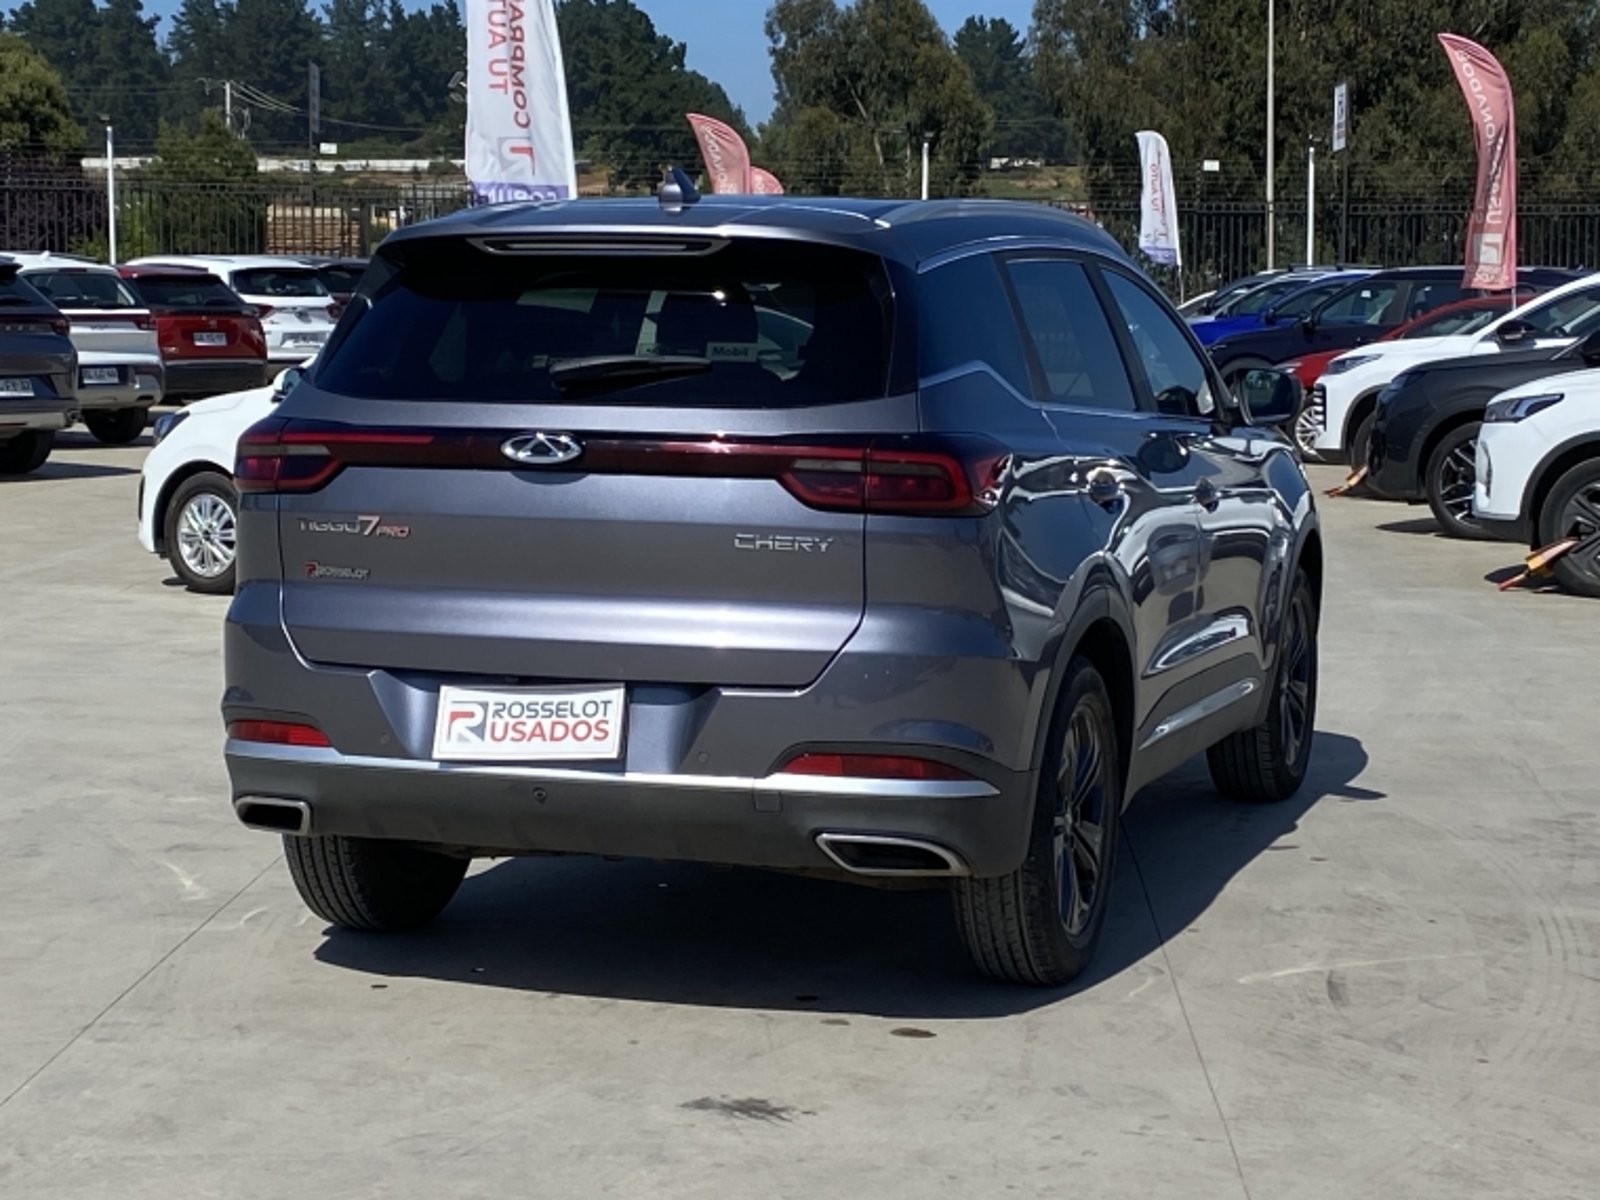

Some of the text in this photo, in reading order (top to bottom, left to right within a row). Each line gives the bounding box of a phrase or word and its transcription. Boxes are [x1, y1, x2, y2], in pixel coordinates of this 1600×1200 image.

[734, 533, 834, 553] CHERY
[491, 700, 613, 719] ROSSELOT
[490, 720, 610, 742] USADOS
